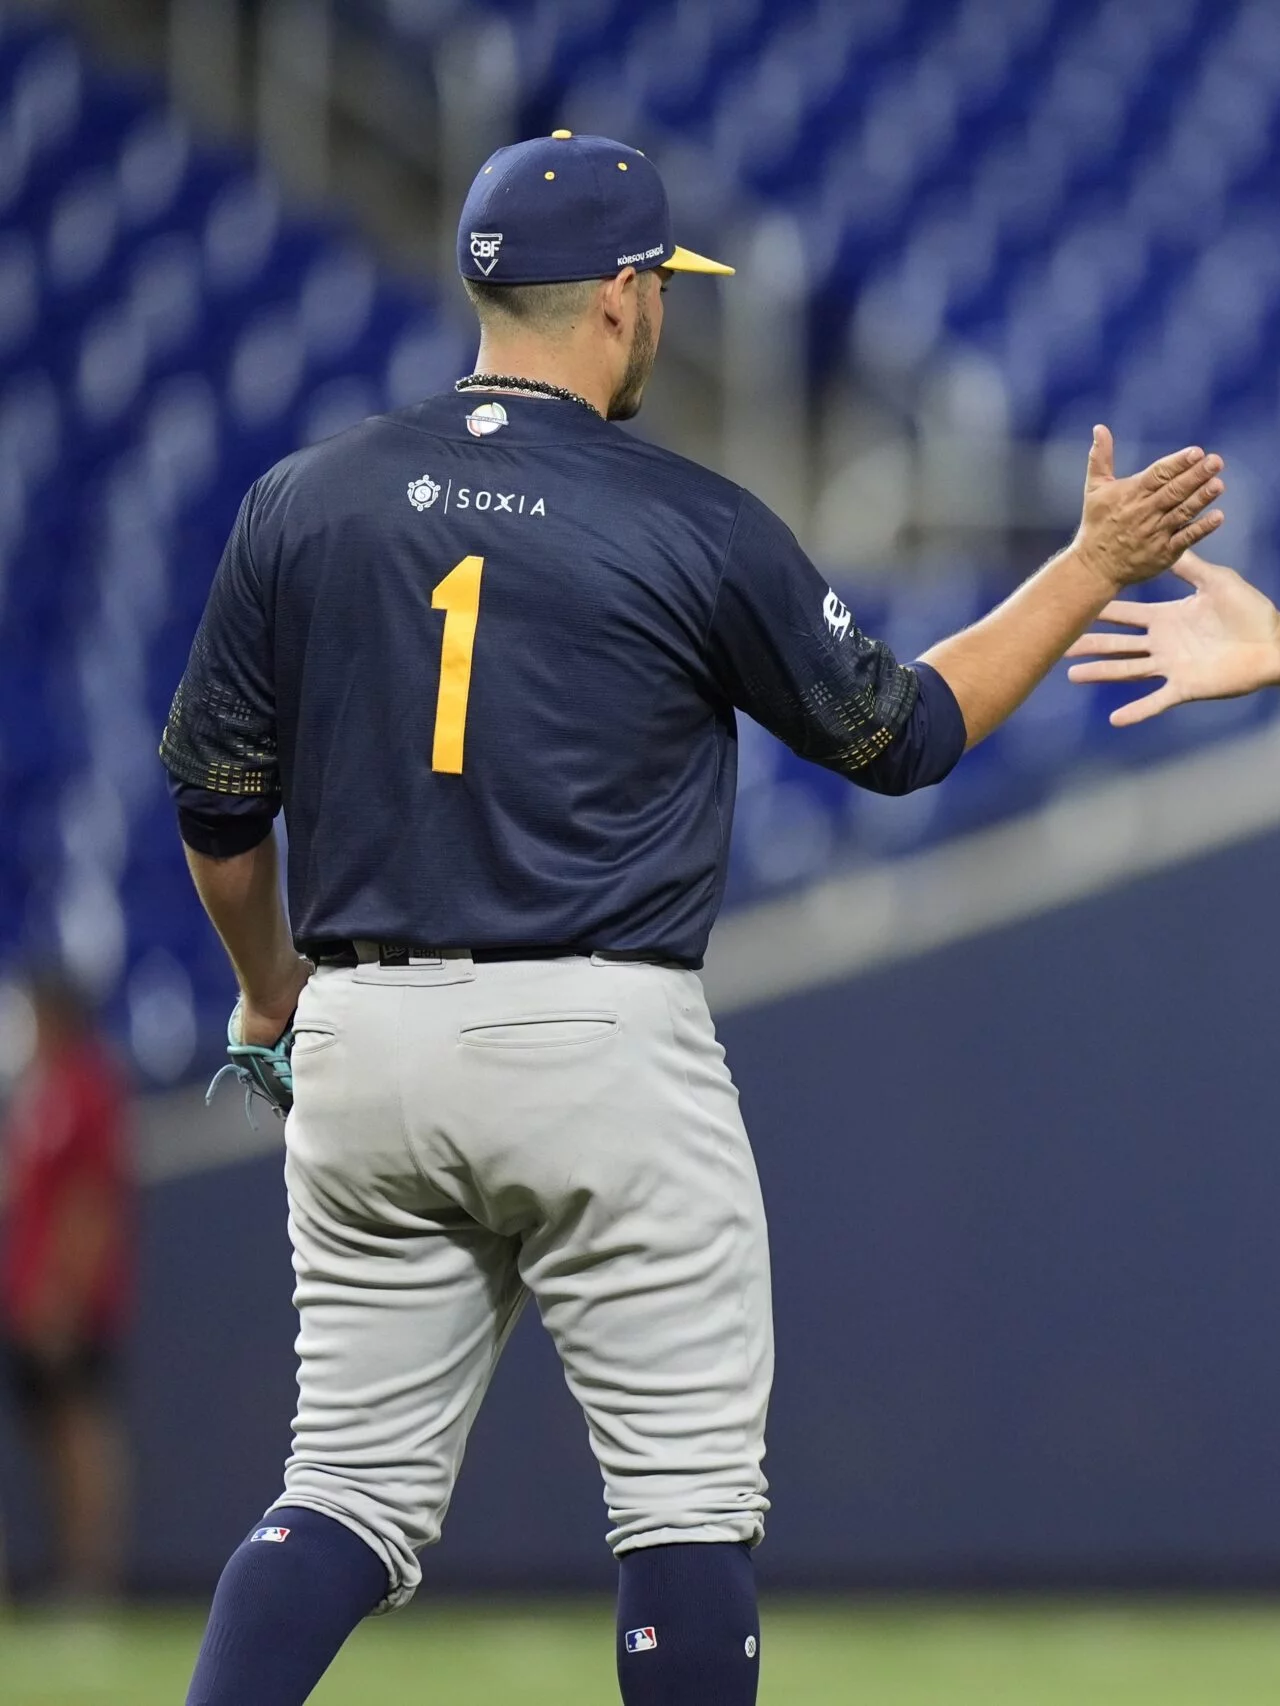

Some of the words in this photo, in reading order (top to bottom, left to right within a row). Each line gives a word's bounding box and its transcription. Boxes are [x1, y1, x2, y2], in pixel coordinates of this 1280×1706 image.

[470, 240, 501, 258] CBF
[456, 488, 546, 516] SOXIA
[431, 555, 484, 774] 1
